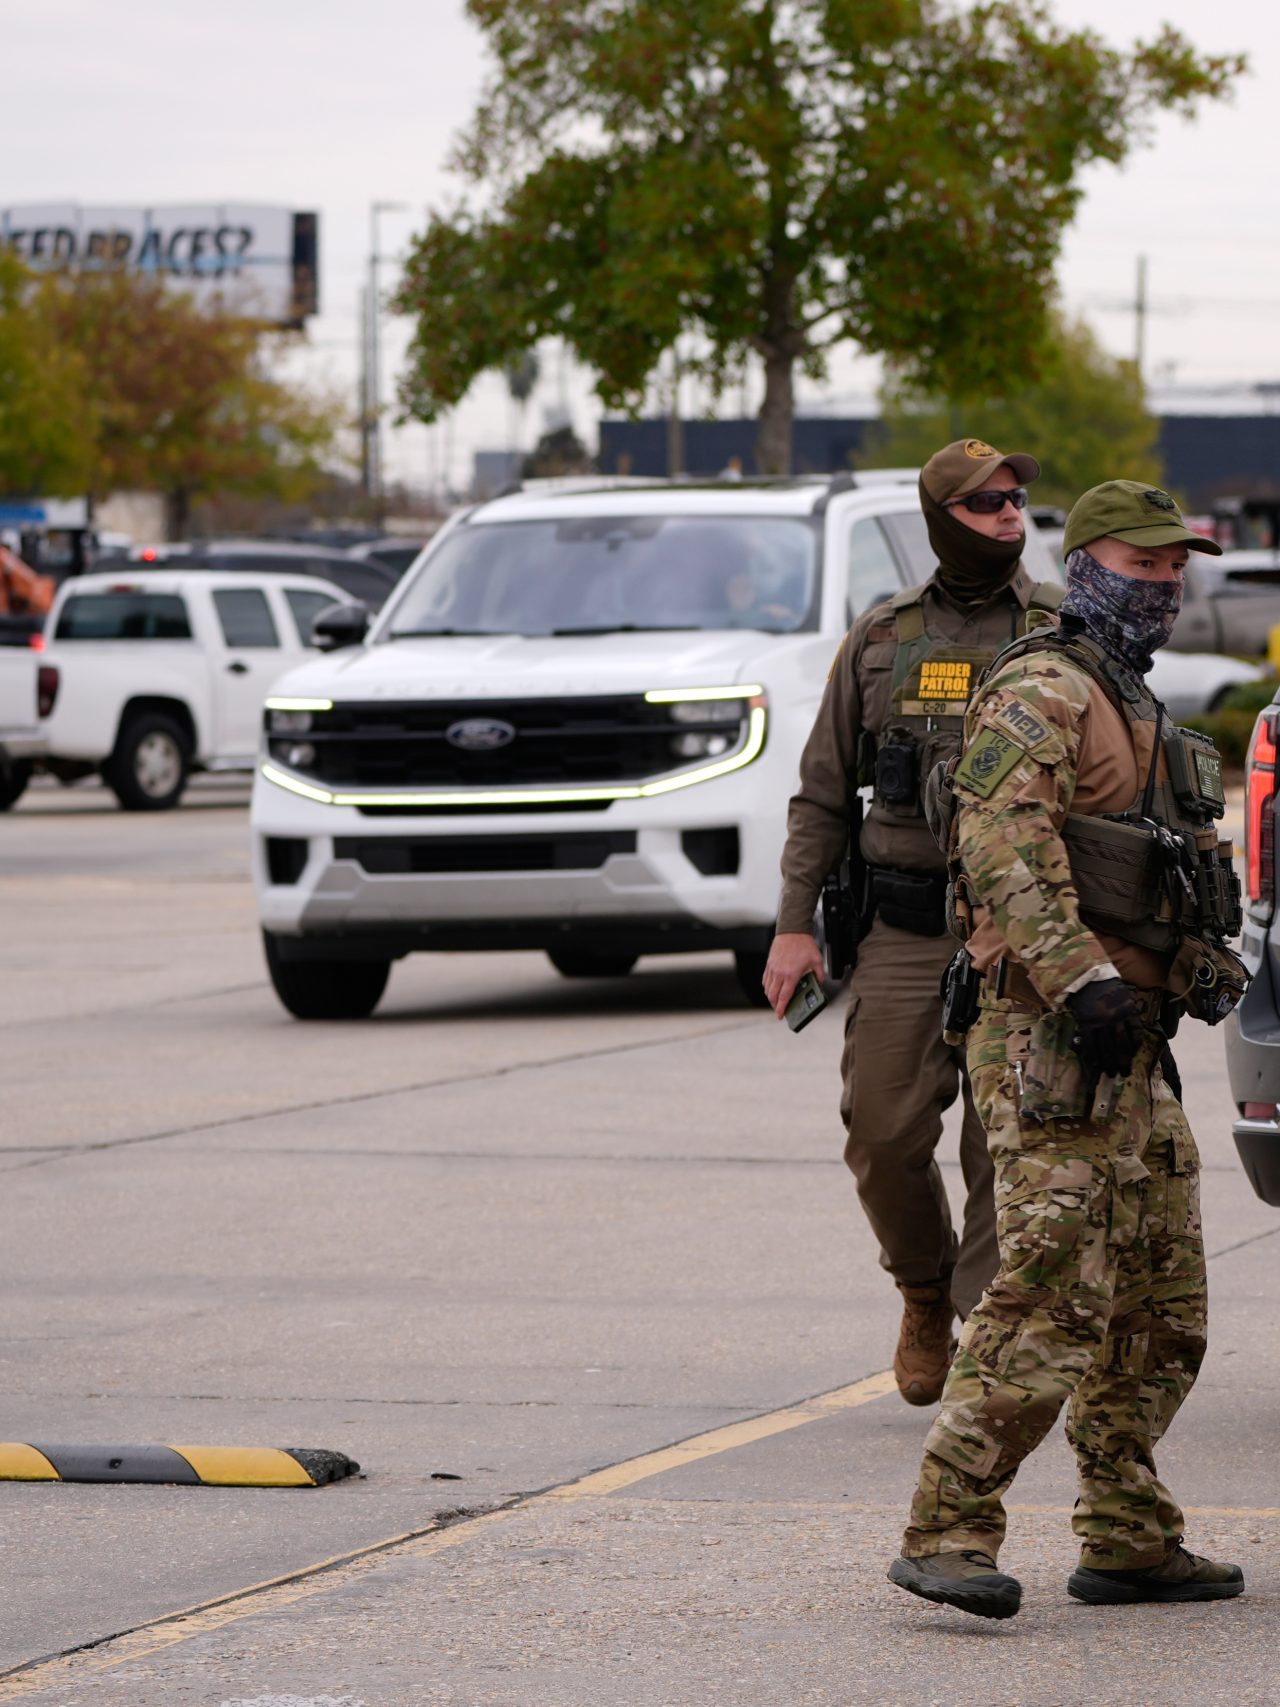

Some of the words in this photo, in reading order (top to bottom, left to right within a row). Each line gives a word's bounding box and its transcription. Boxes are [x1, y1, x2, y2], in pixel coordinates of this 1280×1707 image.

[921, 662, 971, 677] BORDER
[919, 676, 969, 691] PATROL
[918, 690, 945, 698] FEDERAL
[946, 691, 969, 699] AGENT
[923, 703, 946, 713] C-20
[1001, 700, 1047, 742] MED
[990, 735, 1013, 753] ICE
[1195, 754, 1220, 776] POLICE
